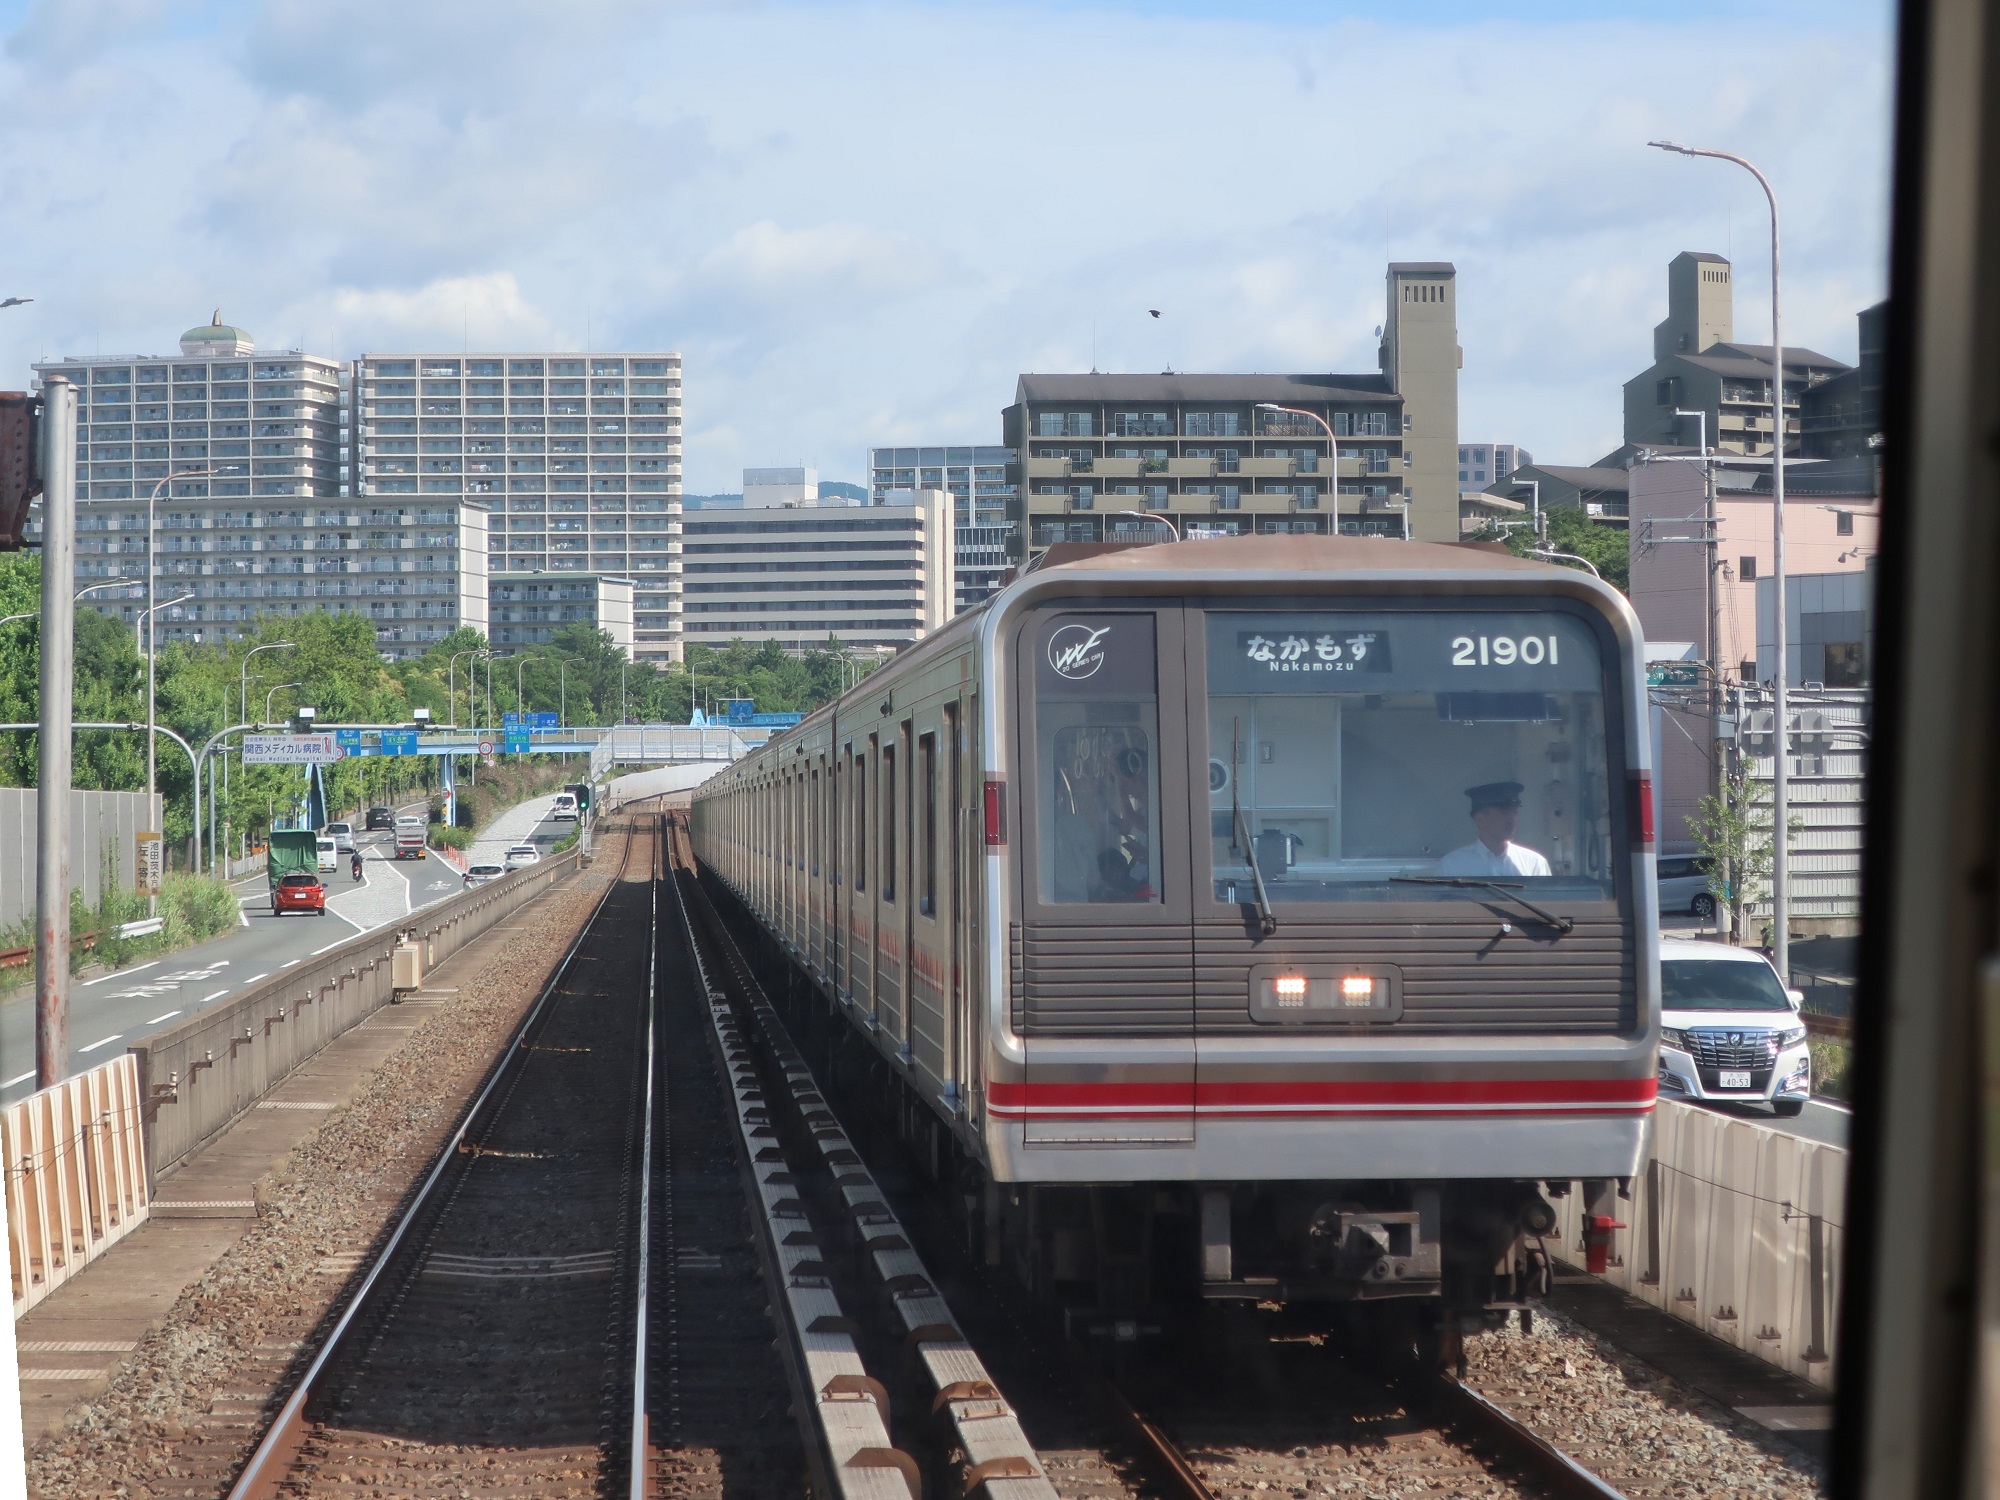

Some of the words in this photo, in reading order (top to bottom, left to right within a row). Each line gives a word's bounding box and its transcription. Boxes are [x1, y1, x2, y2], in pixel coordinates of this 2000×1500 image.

[1247, 634, 1377, 661] なかもず
[1452, 636, 1558, 666] 21901
[1269, 662, 1354, 672] Nakamozu
[244, 743, 322, 755] 関西メディカル病院
[138, 845, 149, 889] 左へ寄れ
